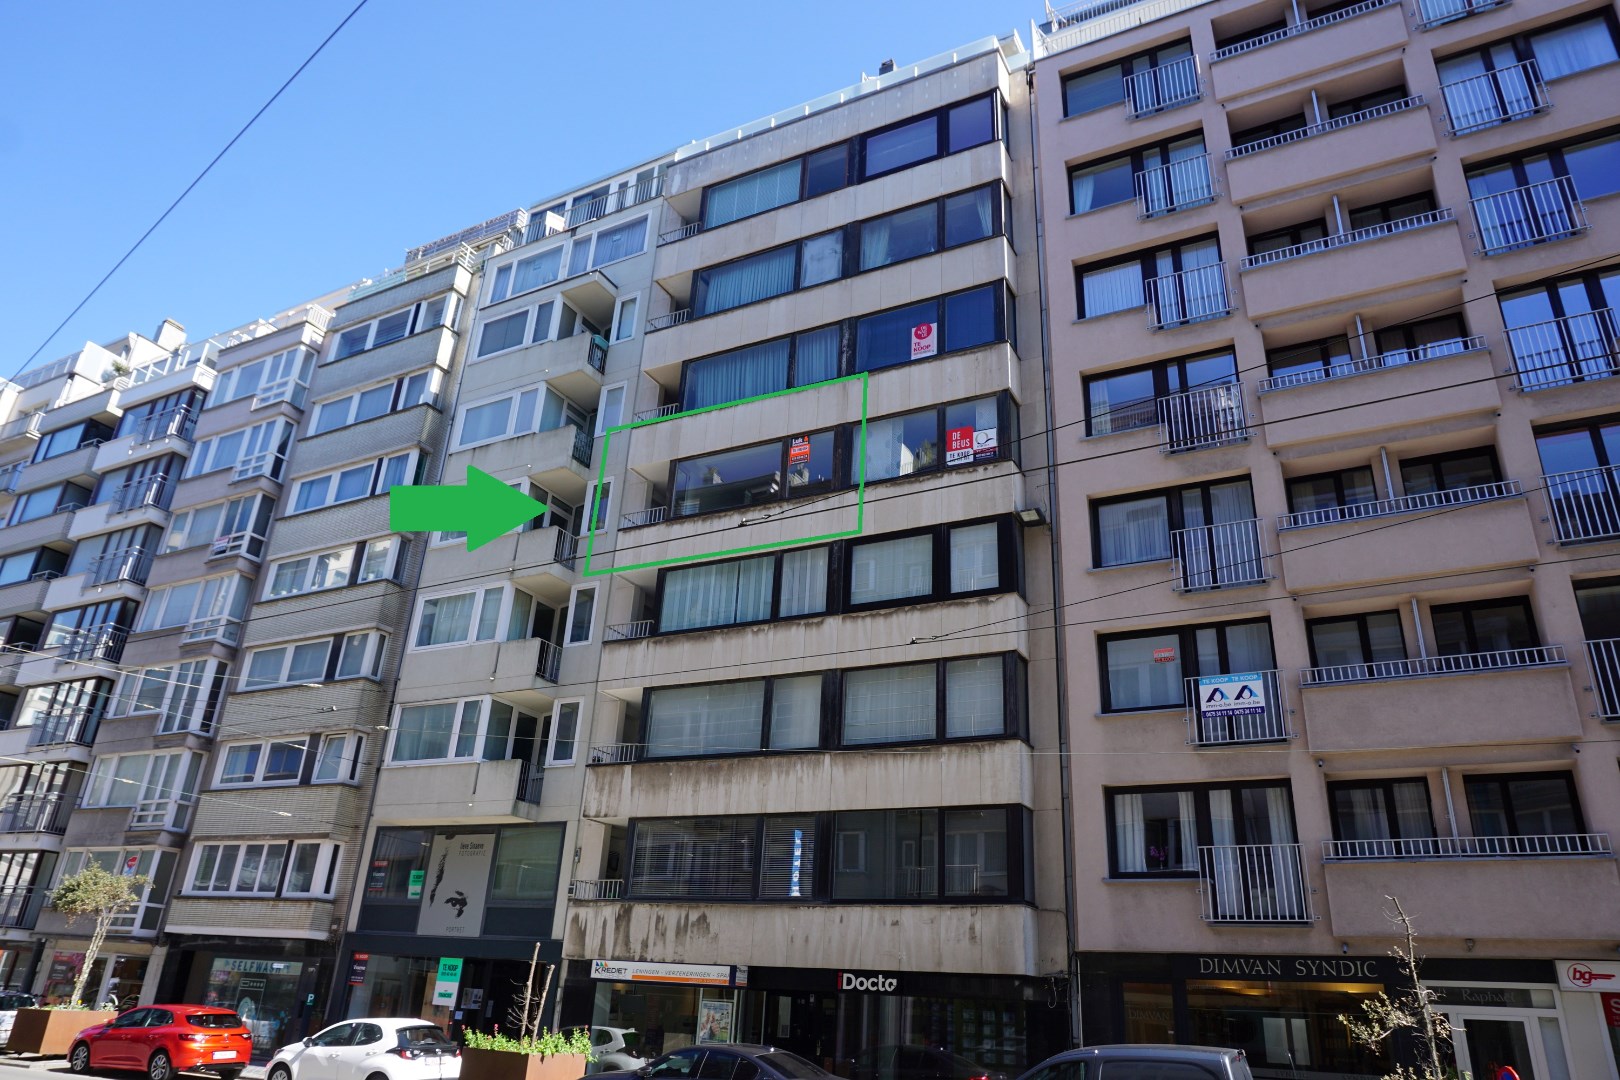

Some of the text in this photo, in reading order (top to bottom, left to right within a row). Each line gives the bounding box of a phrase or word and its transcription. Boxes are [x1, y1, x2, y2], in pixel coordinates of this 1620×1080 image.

[913, 344, 931, 352] KOOP
[952, 431, 961, 440] DE
[952, 439, 970, 449] BEUS
[442, 963, 448, 971] TE
[594, 966, 628, 976] KREDIET
[1199, 957, 1378, 978] DIMVAN SYNDIC
[664, 970, 711, 978] VERZEKERINGEN
[1572, 967, 1592, 984] bg
[307, 993, 315, 1002] P
